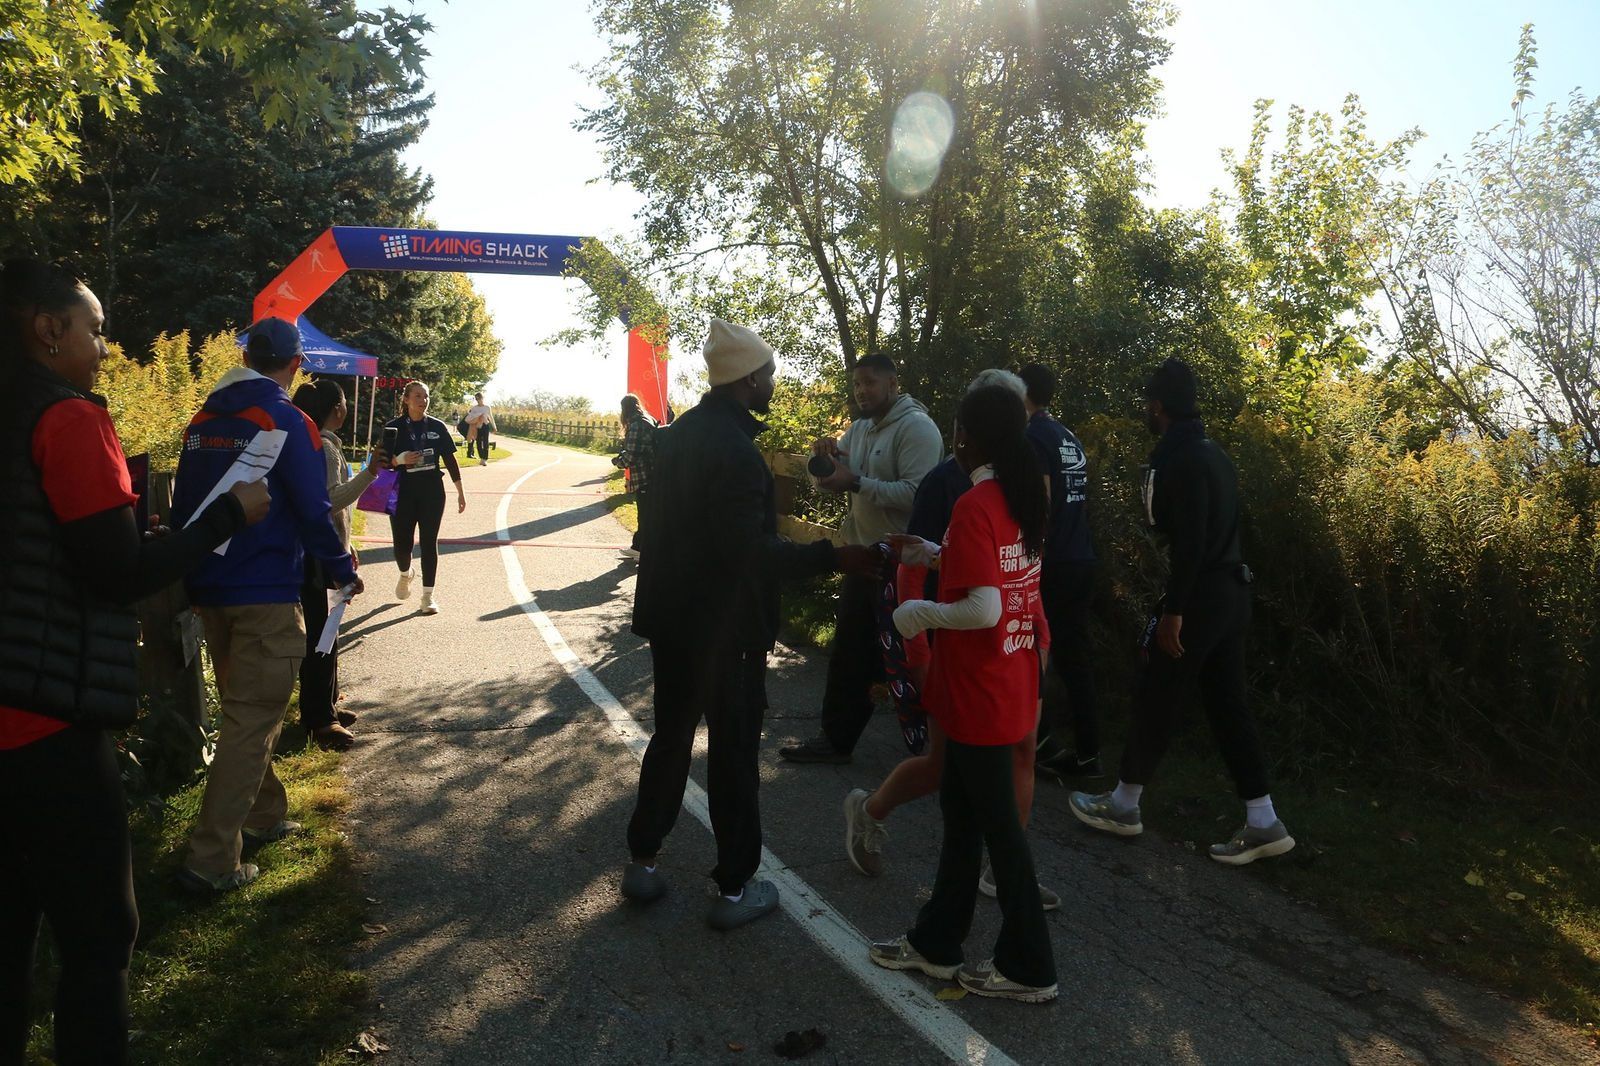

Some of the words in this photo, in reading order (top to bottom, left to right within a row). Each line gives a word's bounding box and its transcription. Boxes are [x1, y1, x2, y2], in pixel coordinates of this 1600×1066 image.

[410, 236, 483, 255] TIMING
[486, 242, 549, 258] SHACK
[234, 438, 250, 448] SHA
[1000, 558, 1018, 573] FOR
